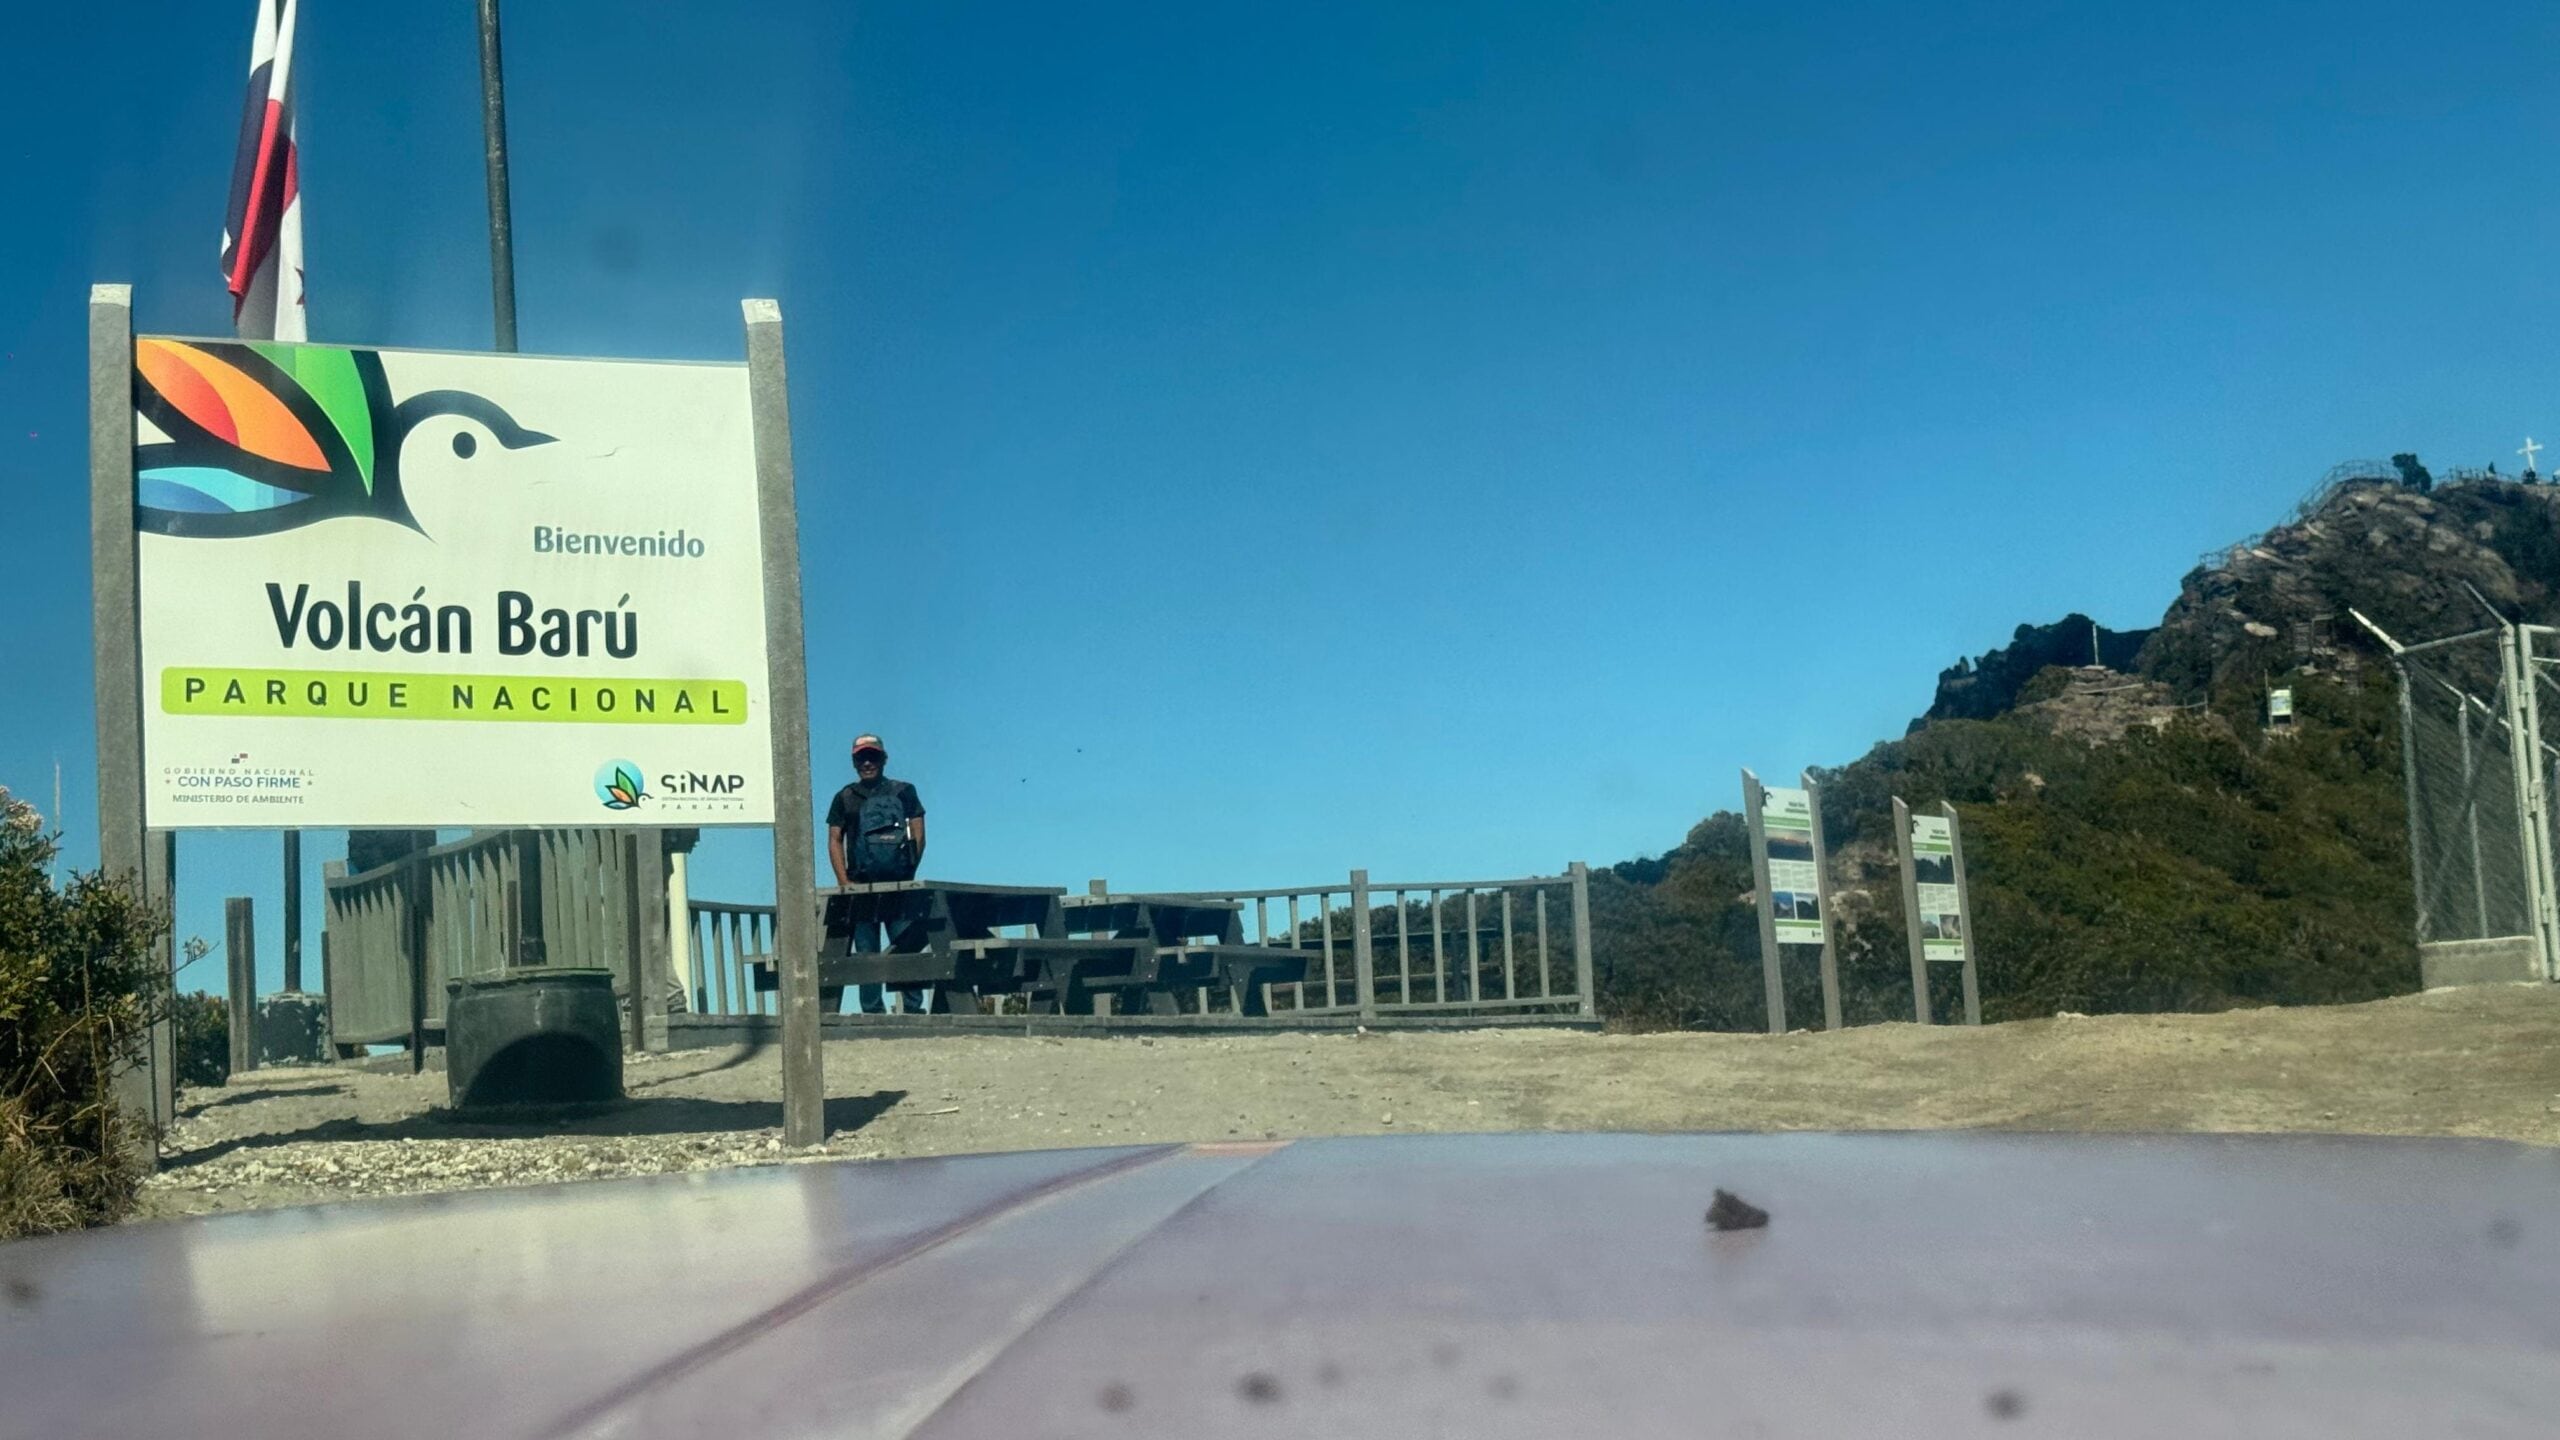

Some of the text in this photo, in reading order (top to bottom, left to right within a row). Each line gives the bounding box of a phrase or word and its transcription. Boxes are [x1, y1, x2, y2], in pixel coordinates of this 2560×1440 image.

[534, 525, 705, 558] Bienvenido
[265, 580, 638, 659] Volcán Barú
[185, 677, 729, 714] PARQUE NACIONAL
[163, 767, 315, 777] GOBIERNO NACIONAL
[177, 775, 301, 789] CON PASO FIRME
[172, 794, 305, 804] MINISTERIO DE AMBIENTE
